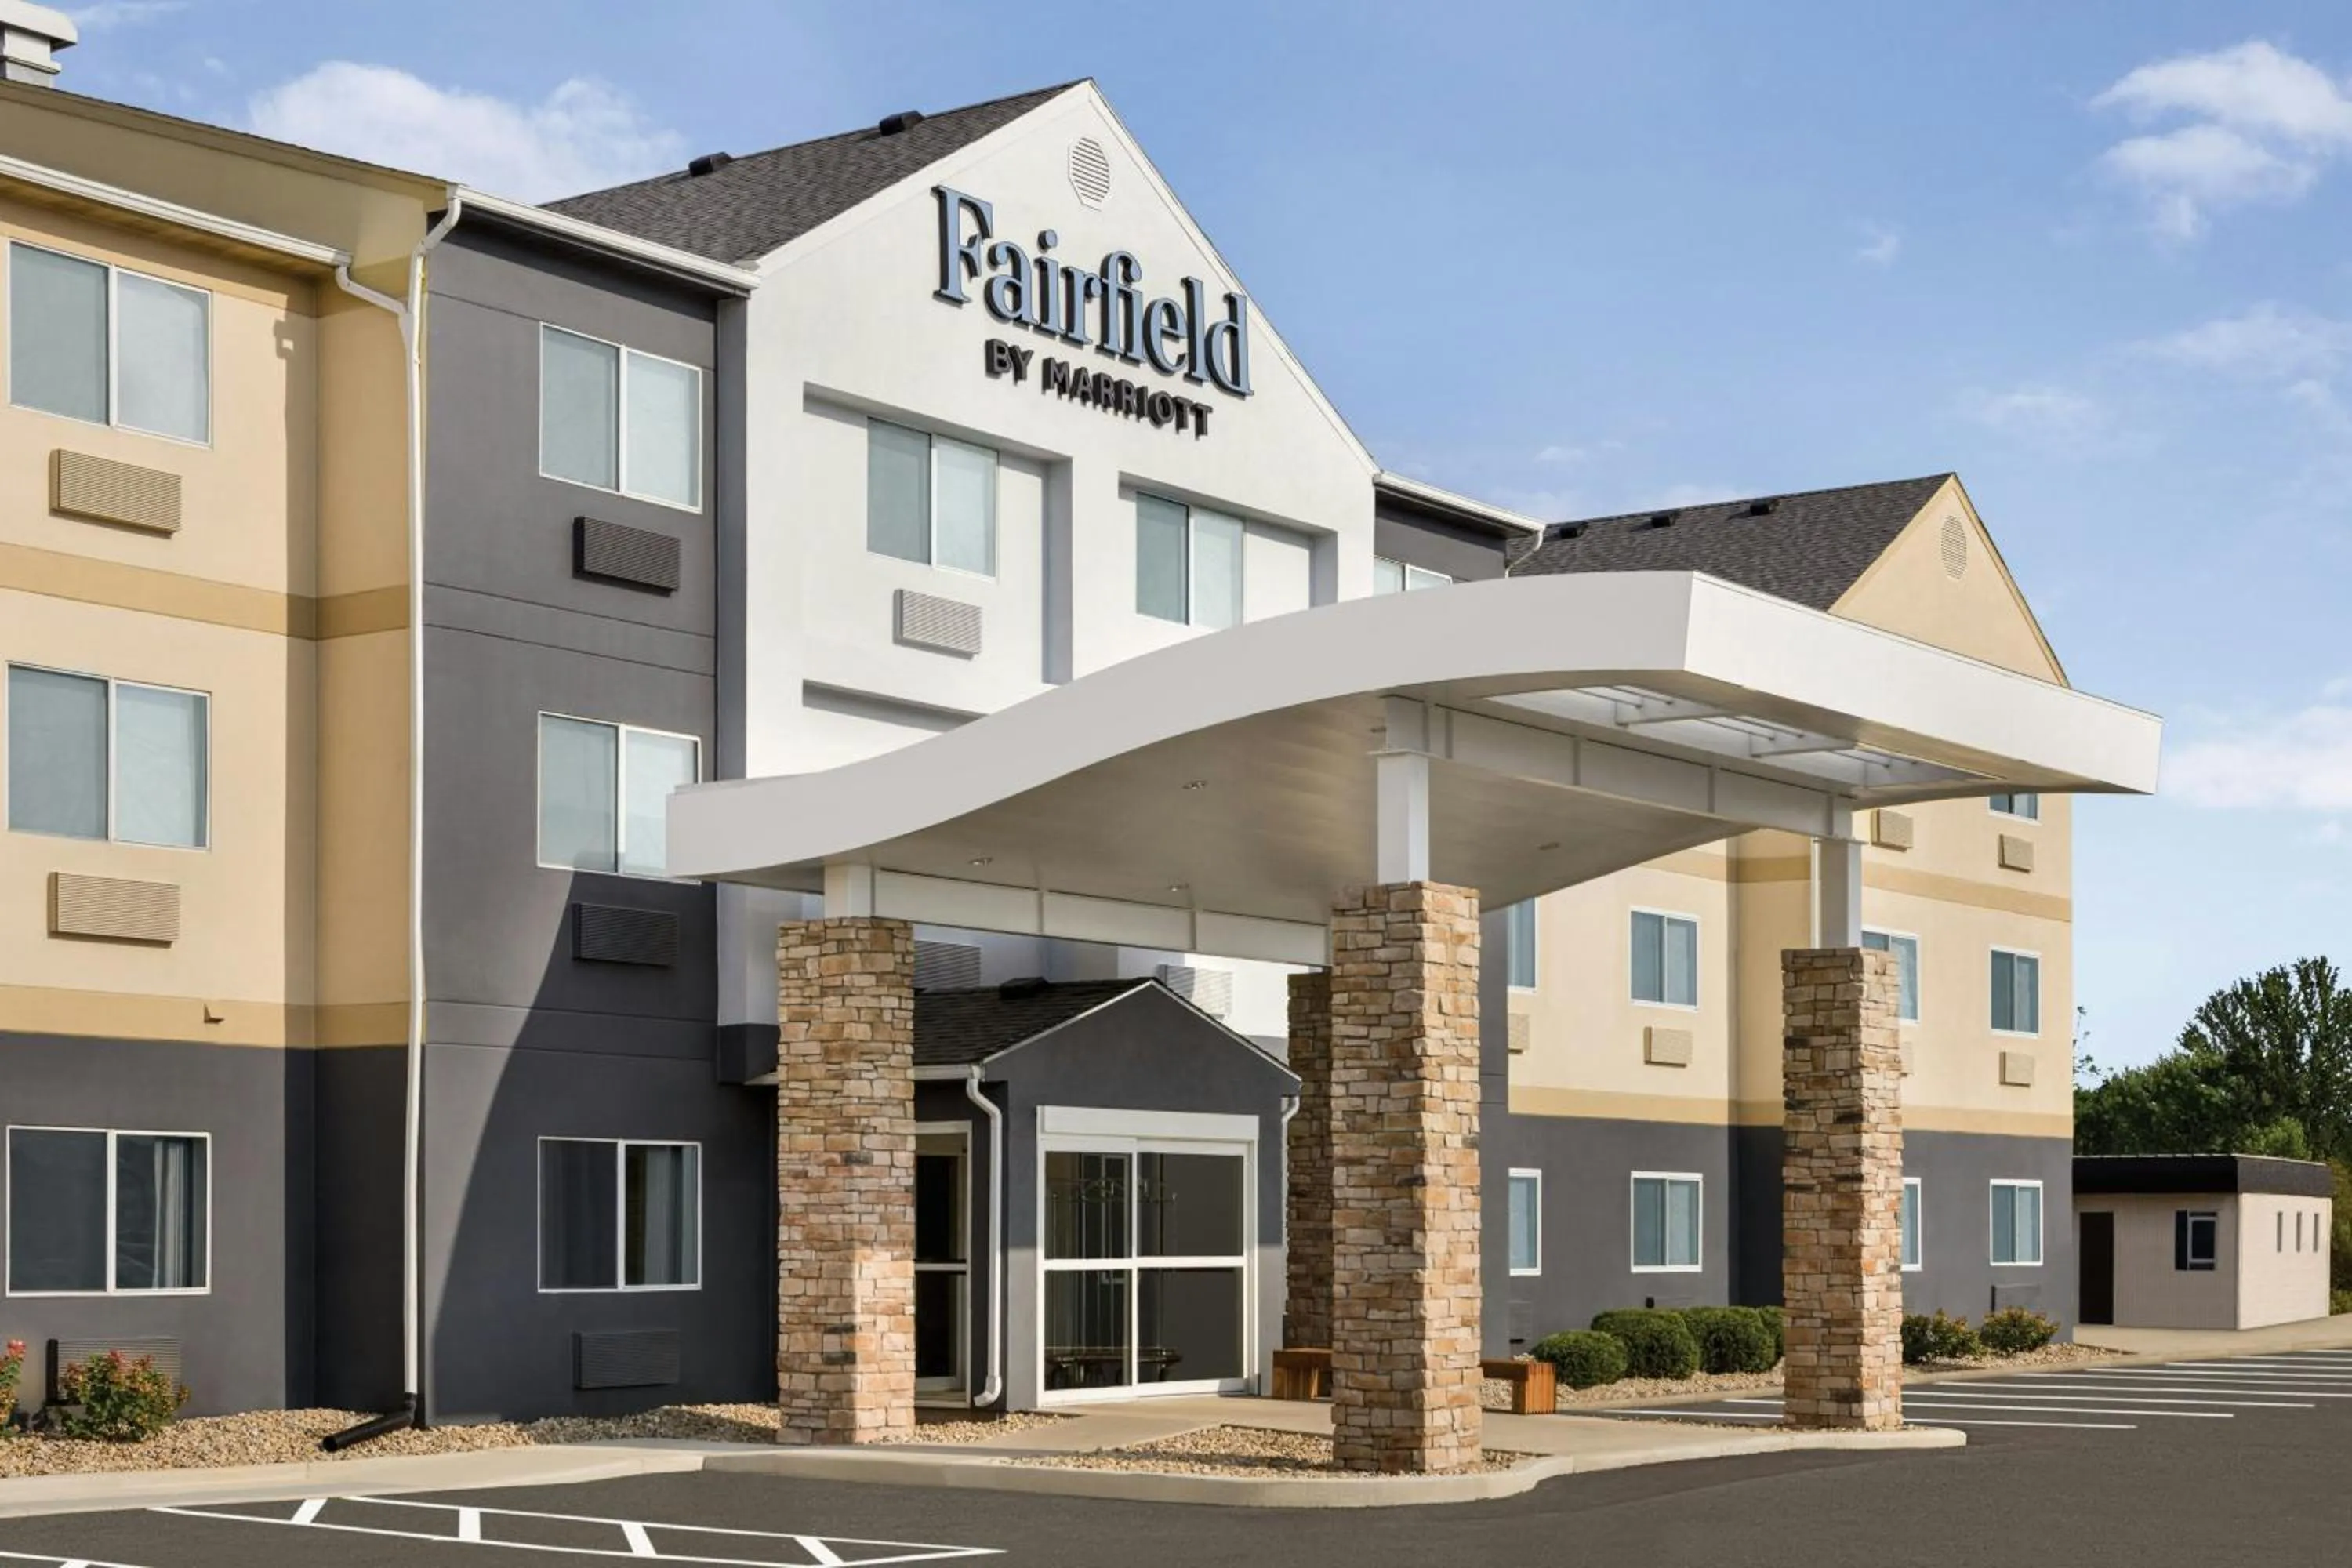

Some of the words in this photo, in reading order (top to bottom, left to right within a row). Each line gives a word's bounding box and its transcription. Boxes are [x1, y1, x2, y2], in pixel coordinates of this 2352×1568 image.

[931, 185, 1254, 399] Fairfield
[985, 338, 1034, 384] BY
[1042, 357, 1213, 439] MARRIOTT
